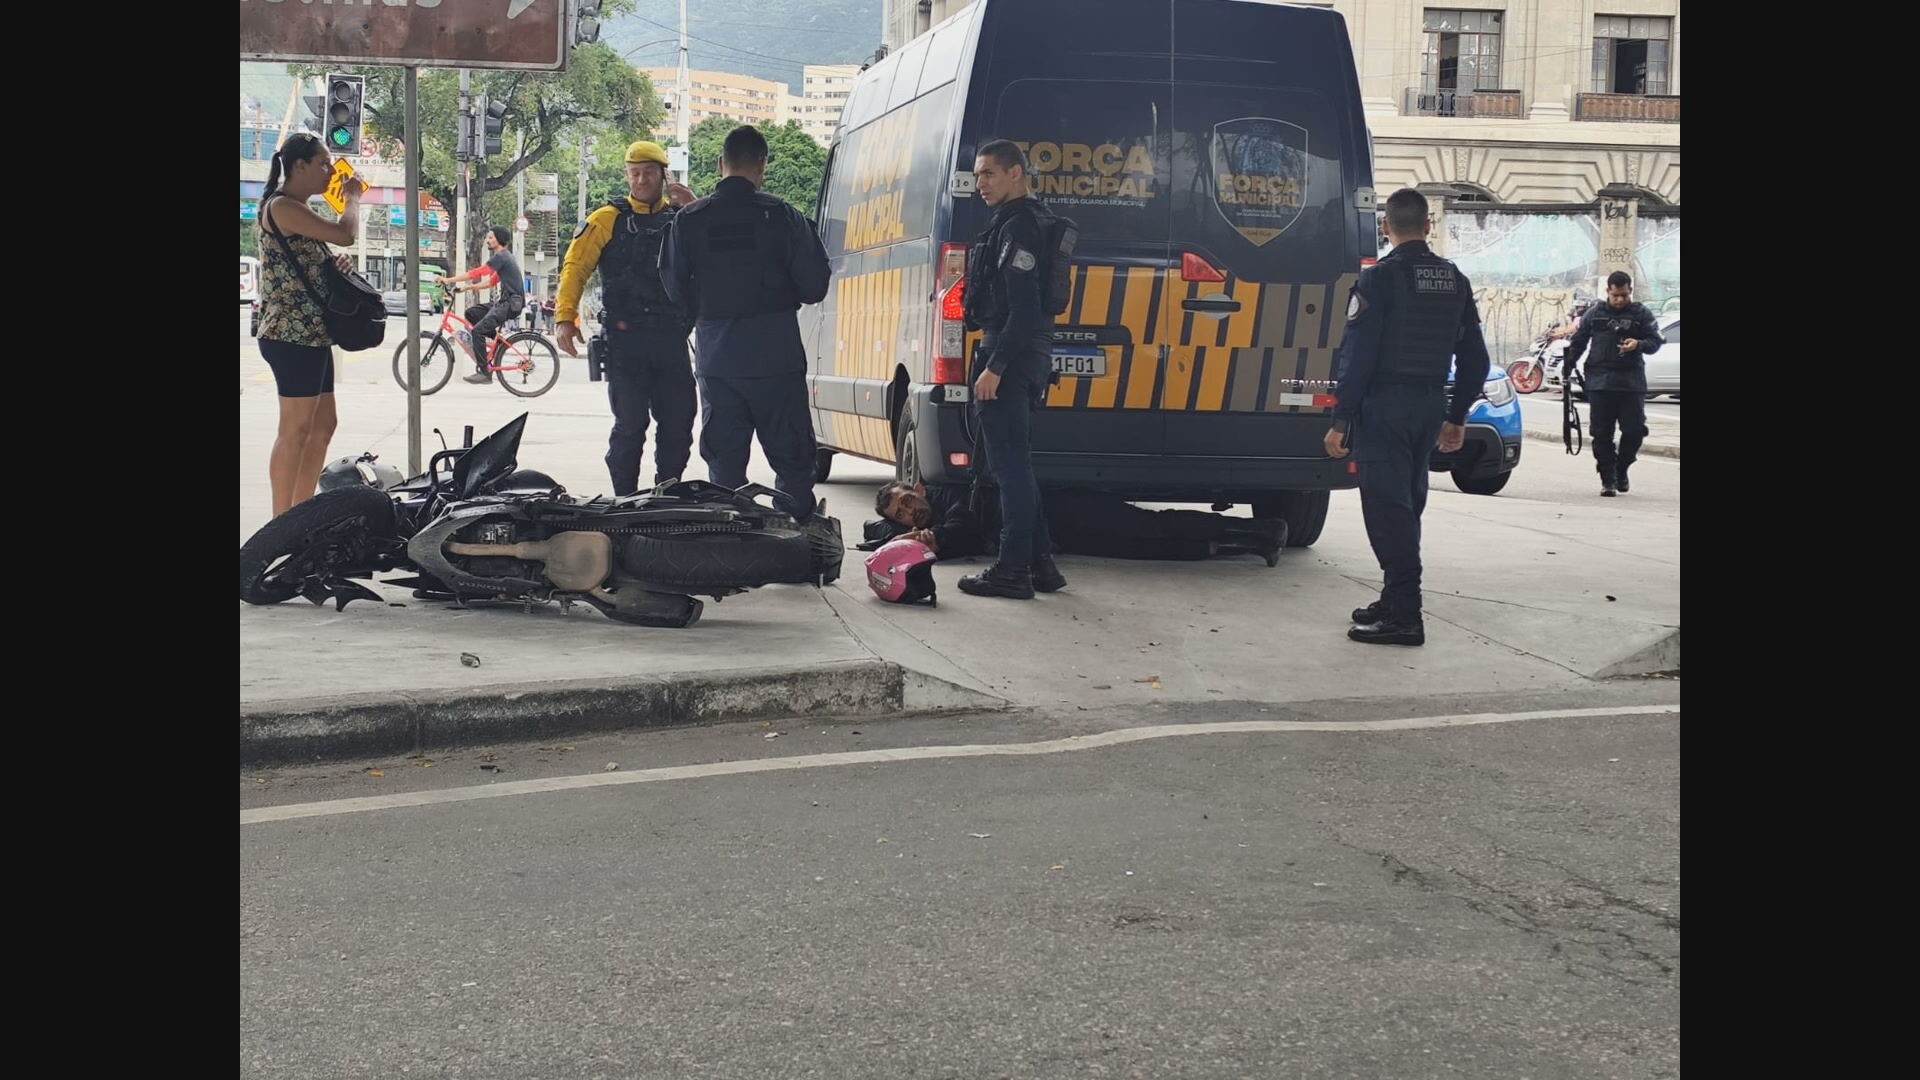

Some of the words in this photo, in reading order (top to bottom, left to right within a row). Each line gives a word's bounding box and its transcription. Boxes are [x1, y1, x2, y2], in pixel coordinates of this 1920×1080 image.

[1025, 174, 1155, 198] UNICIPAL
[1219, 173, 1300, 196] FORÇA
[844, 188, 904, 250] MUNICIPAL
[1418, 279, 1454, 291] MILITAR
[1053, 331, 1097, 341] STER
[1055, 357, 1095, 373] 1F01
[1280, 379, 1338, 389] RENAULT
